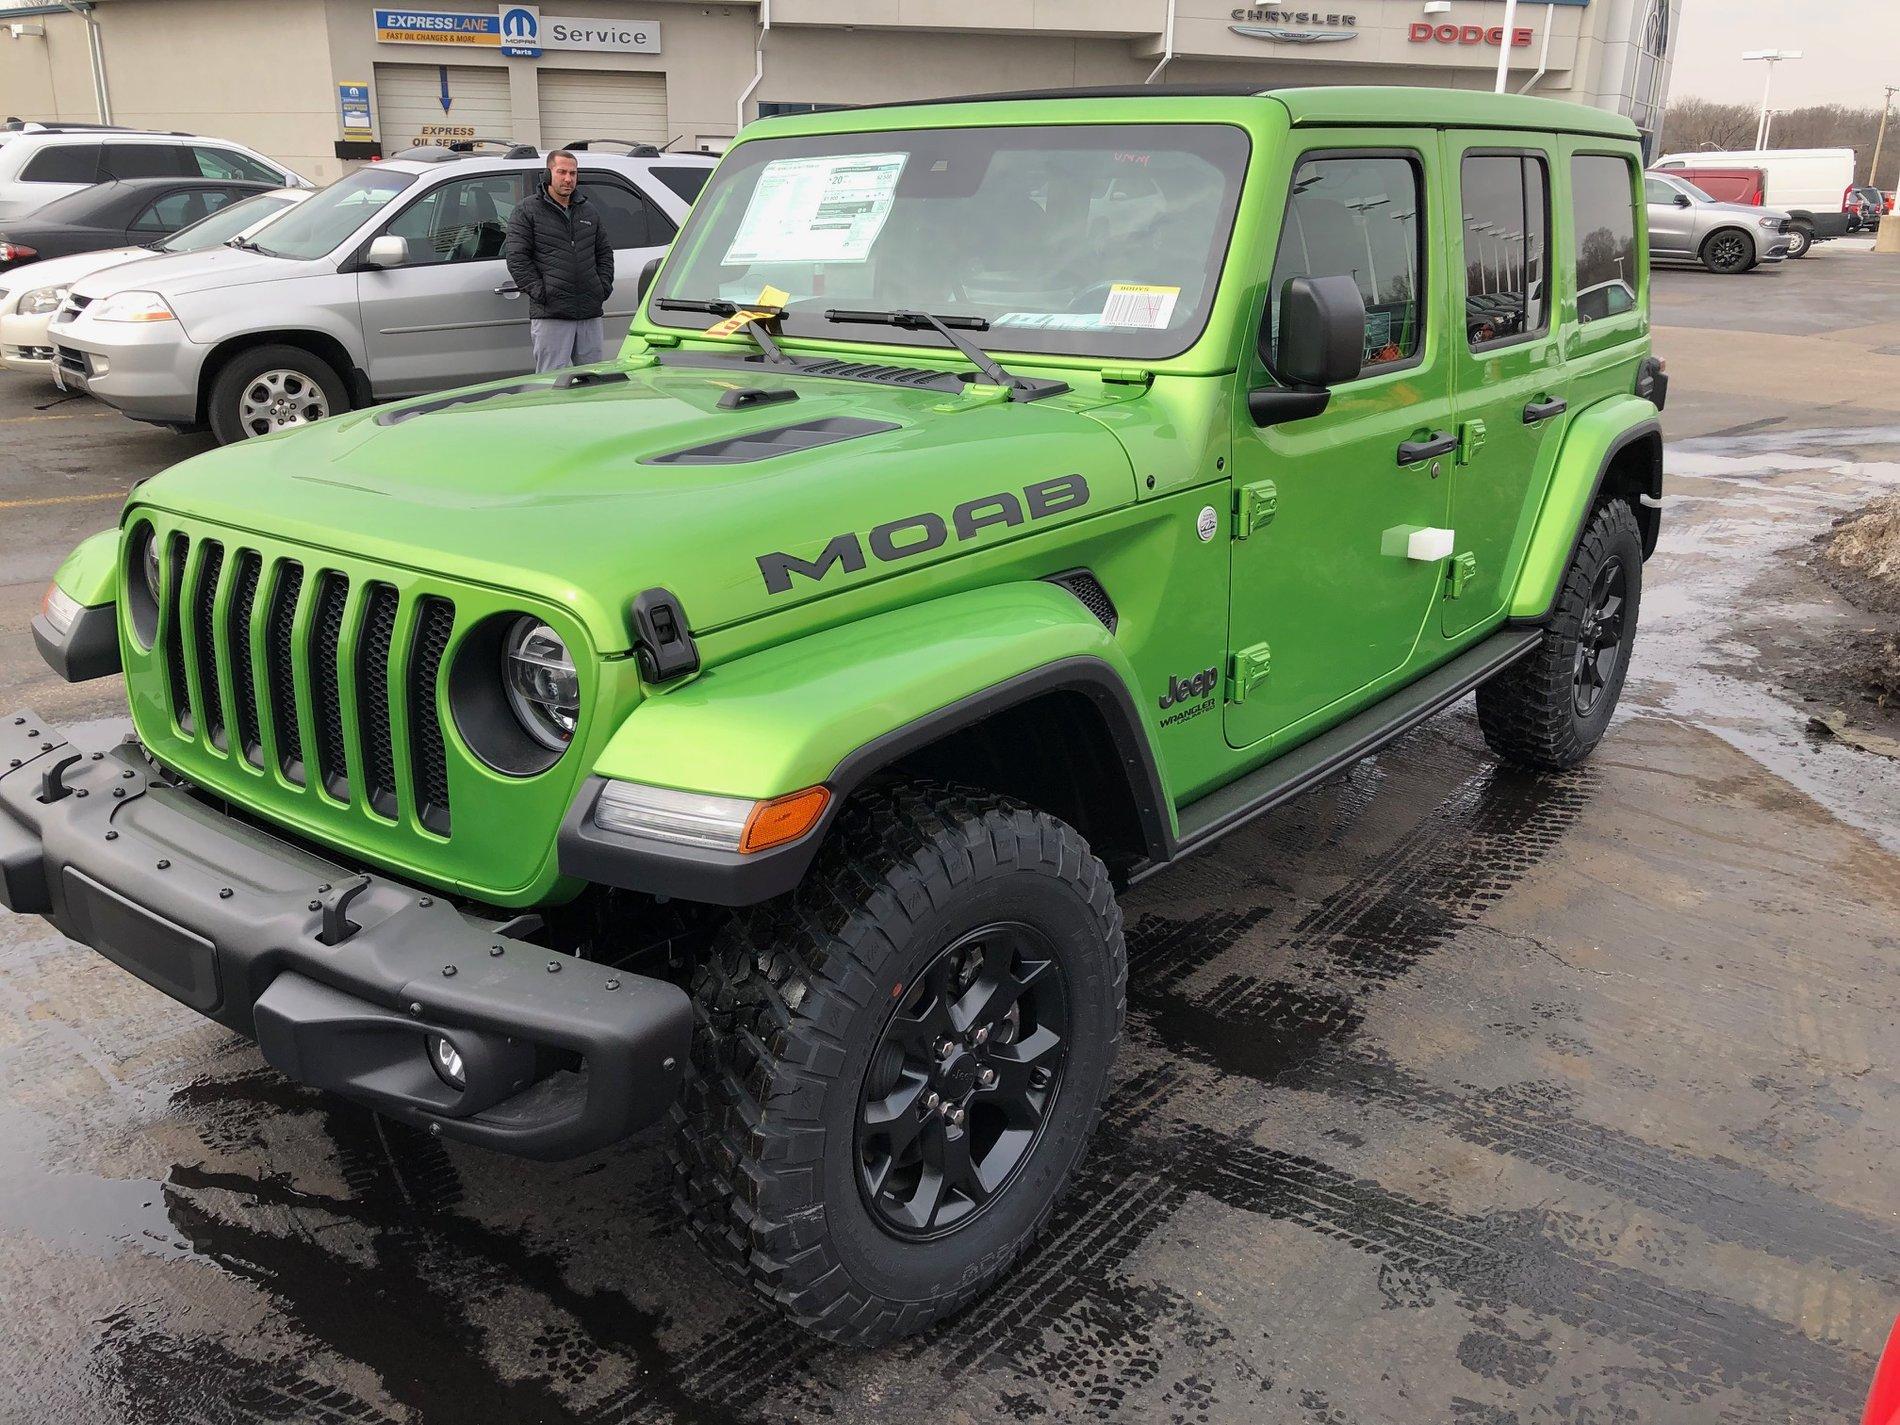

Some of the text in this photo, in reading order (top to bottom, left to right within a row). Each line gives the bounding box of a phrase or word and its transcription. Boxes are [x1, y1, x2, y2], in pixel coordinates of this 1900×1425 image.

[1231, 8, 1357, 26] CHRYSLER
[386, 32, 402, 40] FAST
[416, 34, 448, 42] CHANGES
[456, 35, 476, 43] MORE
[553, 25, 647, 44] Service
[1408, 23, 1534, 46] DODGE
[511, 48, 532, 56] Parts
[422, 126, 475, 136] EXPRESS
[412, 138, 430, 147] OIL
[755, 474, 1090, 595] MOAB
[1158, 667, 1218, 709] Jeep
[1159, 698, 1216, 728] WRANGLER
